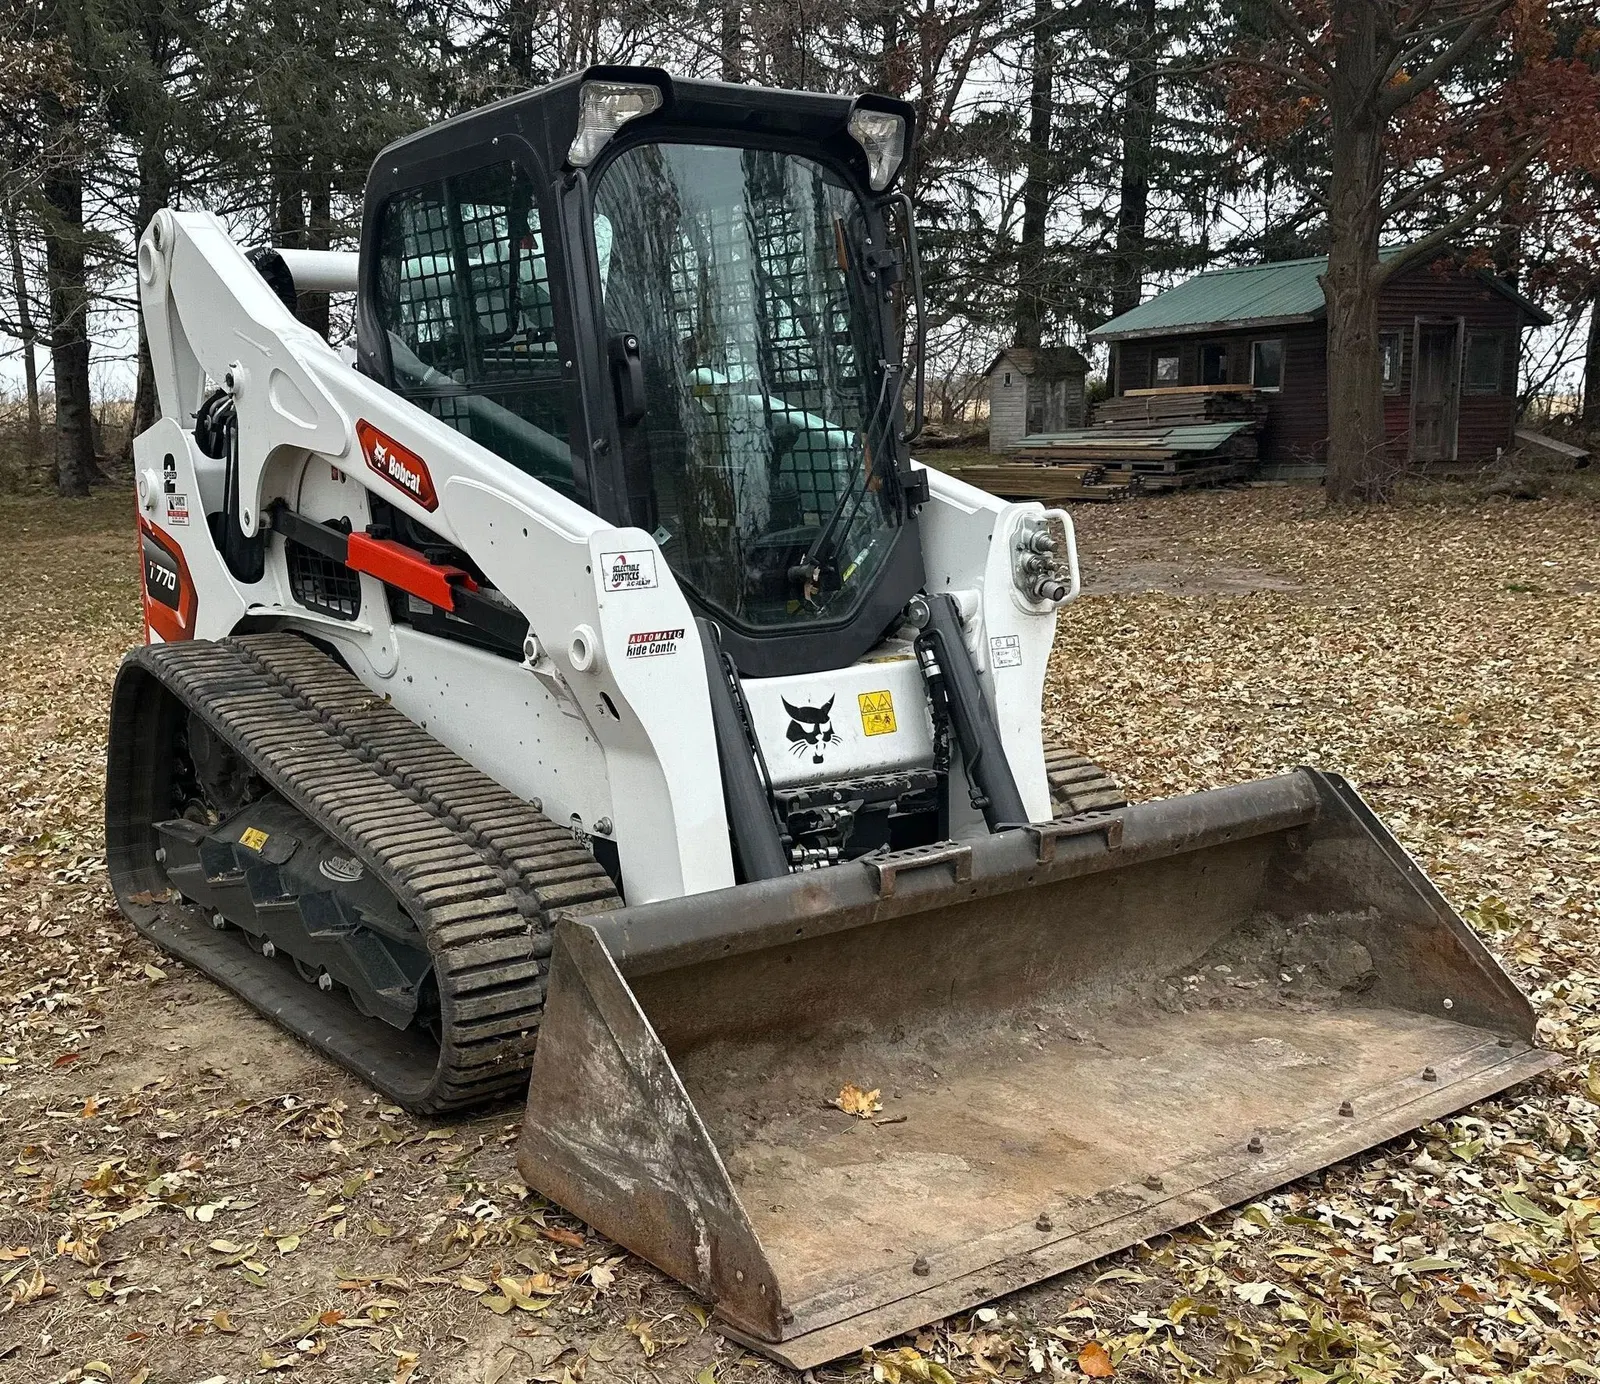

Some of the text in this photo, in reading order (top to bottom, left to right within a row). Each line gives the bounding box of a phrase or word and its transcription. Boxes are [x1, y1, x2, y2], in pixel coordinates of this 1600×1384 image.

[163, 471, 177, 480] SPEED
[388, 454, 421, 495] Bobcat
[149, 560, 177, 591] T770
[630, 630, 683, 643] AUTOMATIC
